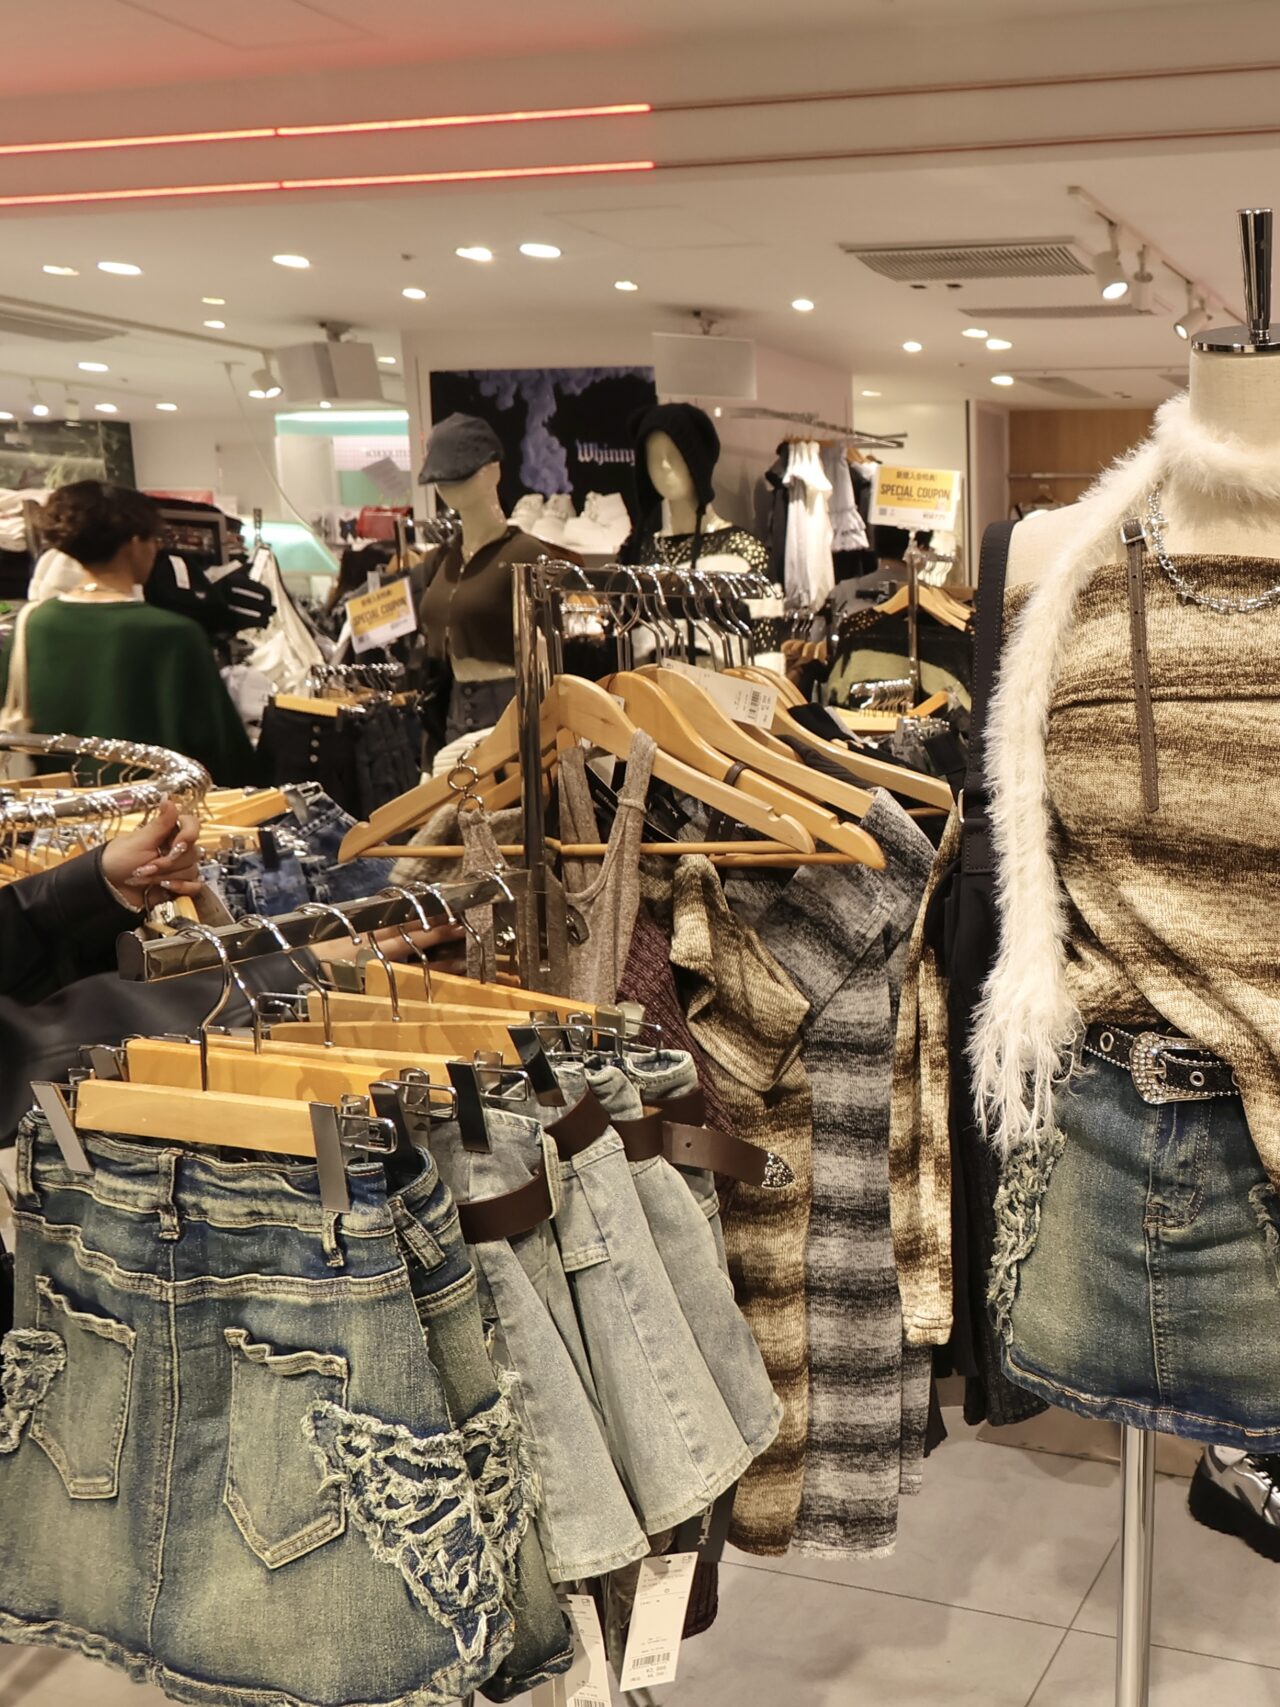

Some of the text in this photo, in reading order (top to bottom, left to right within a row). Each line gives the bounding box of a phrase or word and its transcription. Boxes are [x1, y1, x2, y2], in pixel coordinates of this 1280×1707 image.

[576, 439, 635, 466] Whinny
[881, 484, 913, 498] SPECIAL
[917, 487, 950, 500] COUPON
